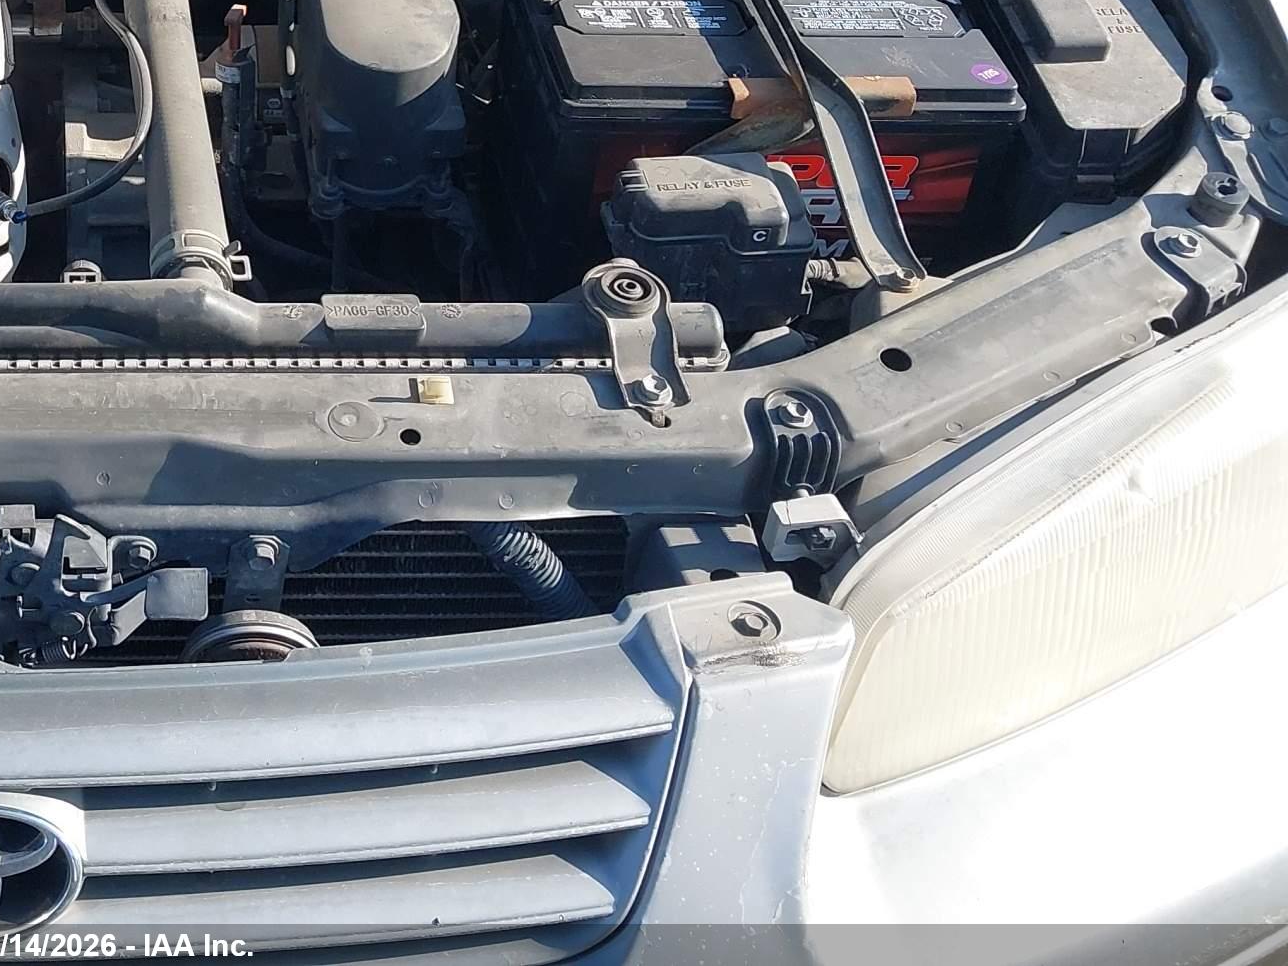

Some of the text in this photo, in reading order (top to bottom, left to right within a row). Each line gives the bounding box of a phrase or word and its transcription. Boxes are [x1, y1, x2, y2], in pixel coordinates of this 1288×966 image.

[1107, 25, 1143, 34] FUSE
[656, 181, 700, 192] RELAY
[714, 179, 752, 188] FUSE
[752, 230, 768, 242] C
